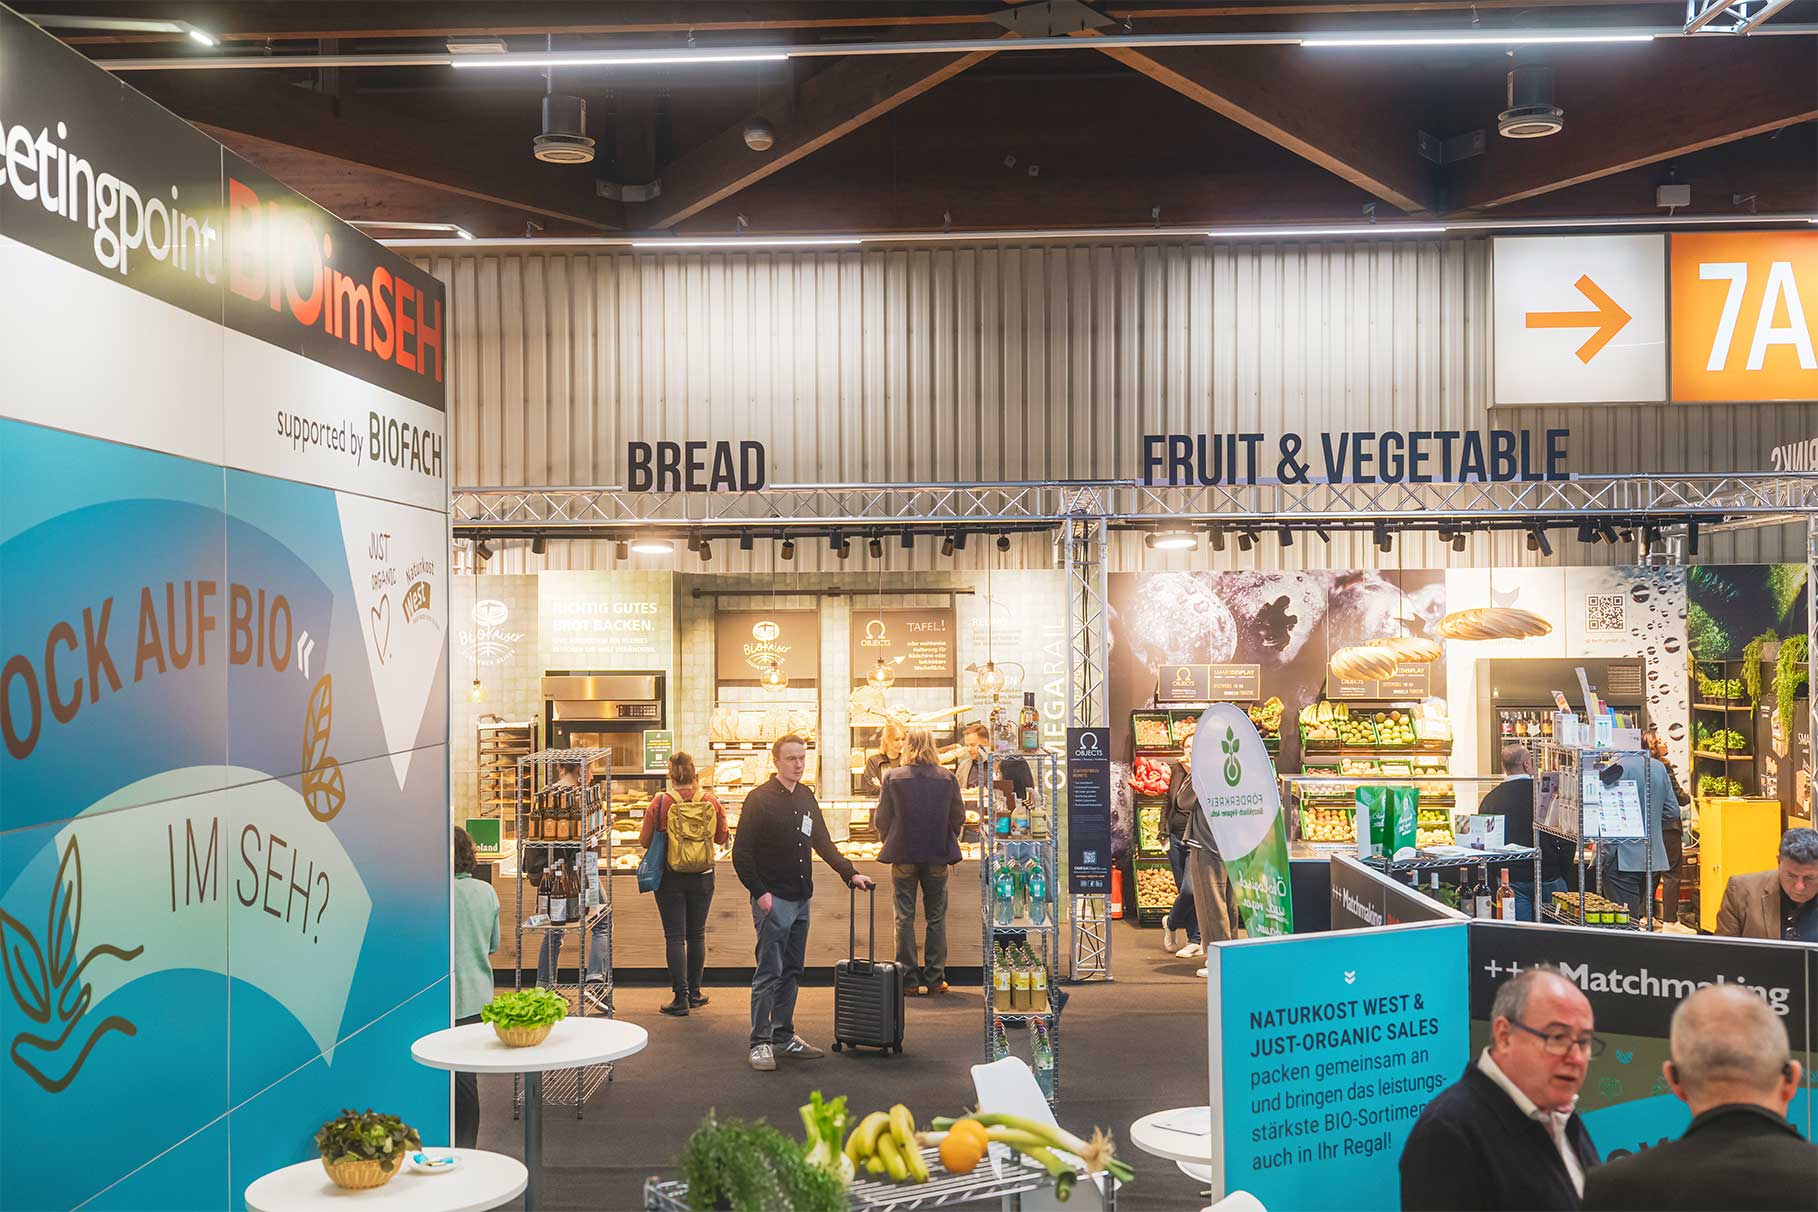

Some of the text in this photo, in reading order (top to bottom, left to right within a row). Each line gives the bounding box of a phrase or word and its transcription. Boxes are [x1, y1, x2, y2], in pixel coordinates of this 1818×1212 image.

[1698, 261, 1818, 372] 7A
[277, 411, 442, 479] supported by BIOFACH
[1143, 428, 1571, 485] FRUIT & VEGETABLE
[627, 440, 766, 492] BREAD
[369, 531, 391, 563] JUST
[614, 602, 657, 614] GUTES
[133, 580, 218, 683] AUF
[229, 583, 293, 673] BIO
[1075, 749, 1104, 757] OBJECTS
[168, 816, 332, 945] IM SEH?
[1250, 993, 1425, 1029] NATURKOST WEST &
[1250, 1017, 1440, 1058] JUST-ORGANIC SALES
[1251, 1049, 1429, 1090] packen gemeinsam an
[1251, 1073, 1448, 1115] und bringen das leistungs-
[1252, 1119, 1320, 1143] stärkste
[1252, 1131, 1392, 1171] auch in Ihr Regal!
